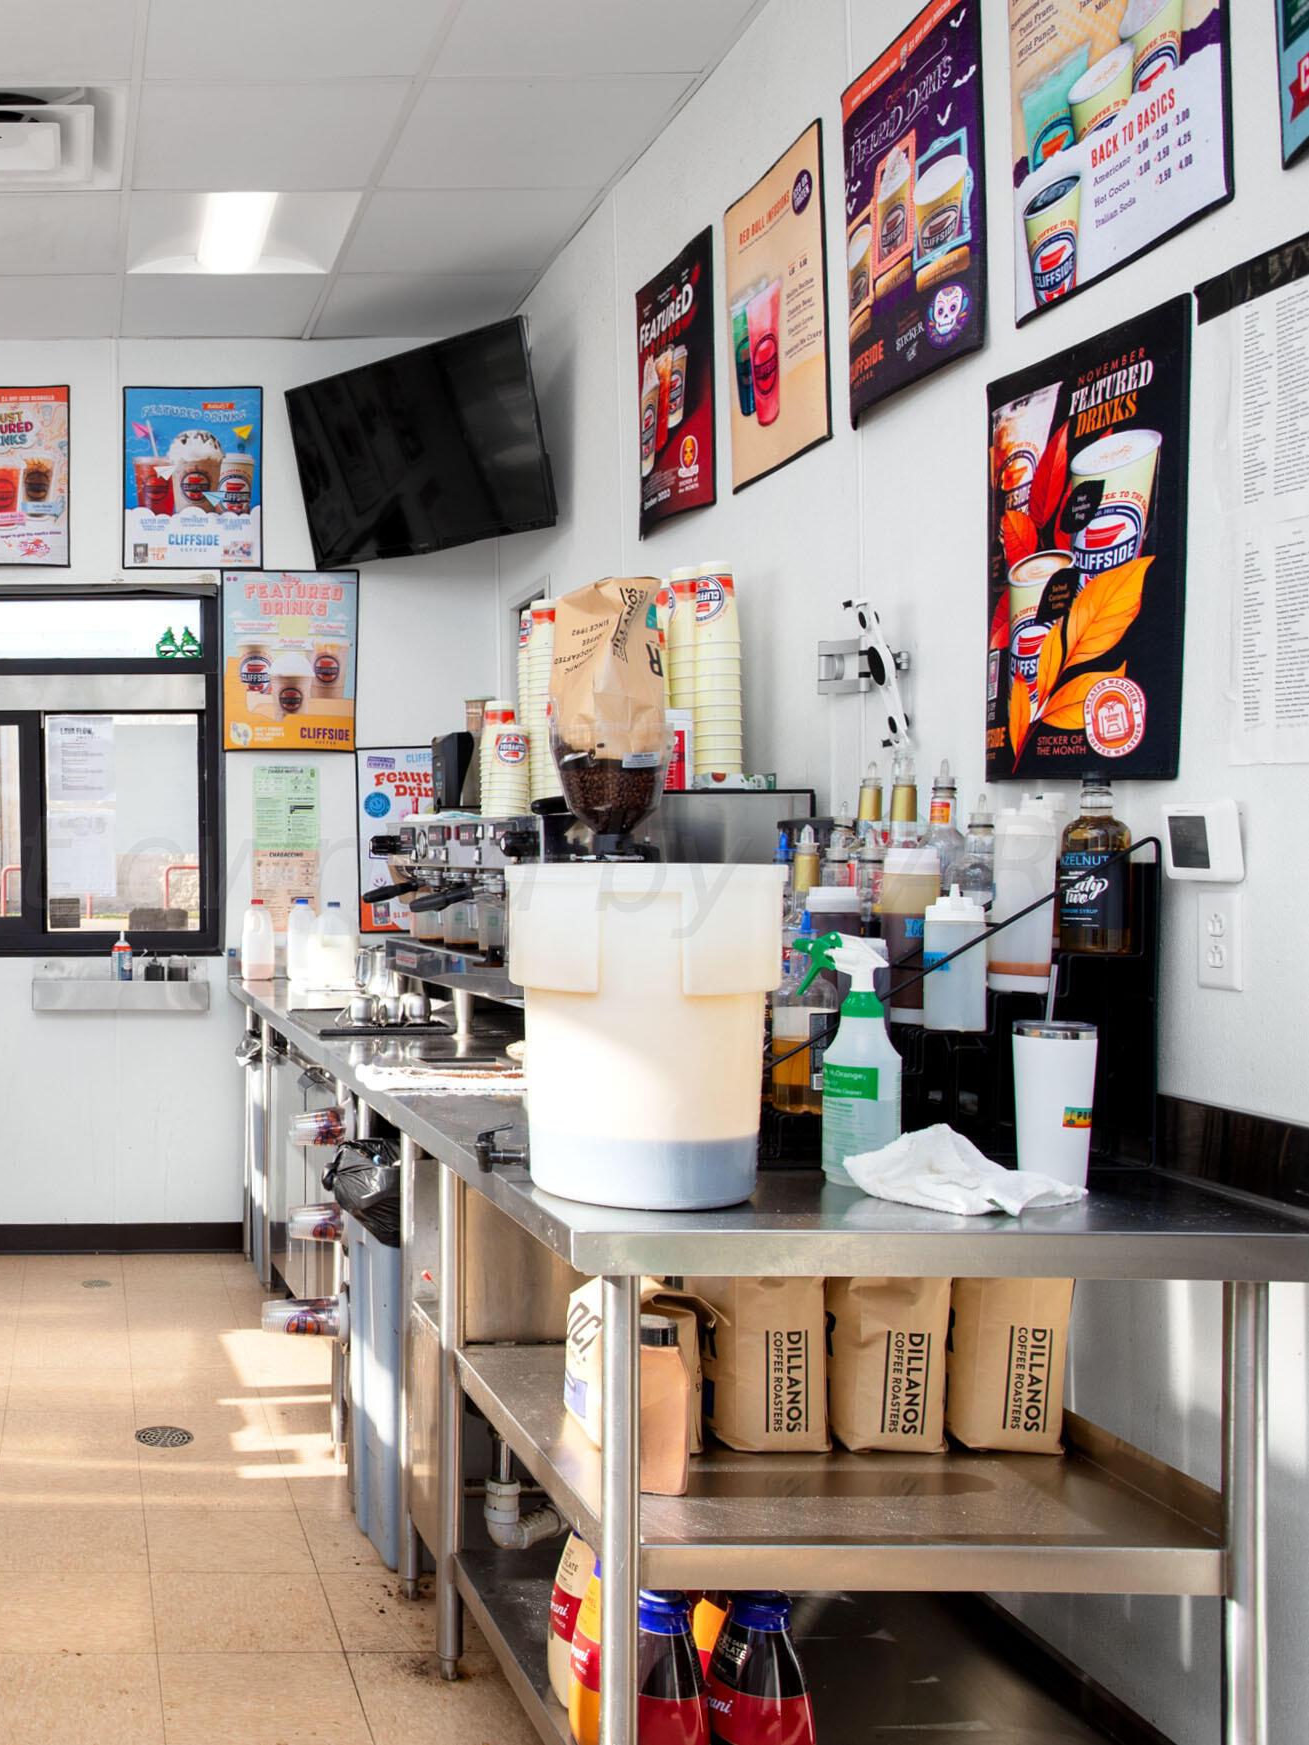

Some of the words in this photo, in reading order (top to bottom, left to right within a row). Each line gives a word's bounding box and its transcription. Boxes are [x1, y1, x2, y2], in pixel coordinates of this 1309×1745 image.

[1033, 24, 1056, 46] Punch
[850, 105, 903, 177] FEATURED
[905, 55, 953, 121] DRINKS
[1091, 132, 1119, 168] BACK
[1122, 121, 1134, 145] TO
[1137, 88, 1176, 134] BASICS
[1093, 156, 1131, 187] Americano
[1094, 194, 1107, 207] Hot
[1108, 179, 1130, 198] Cocoa
[739, 227, 750, 246] RED
[751, 215, 765, 238] BULL
[766, 189, 790, 224] INFUSIONS
[1095, 209, 1118, 228] Italian
[1119, 197, 1136, 213] Soda
[882, 227, 905, 246] CLIFFSIDE
[923, 220, 957, 247] CLIFFSIDE
[1034, 256, 1073, 288] CLIFFSIDE
[640, 283, 693, 348] FEATURED
[895, 321, 924, 351] STICKER
[1077, 347, 1145, 387] NOVEMBER
[1068, 359, 1154, 417] FEATURED
[141, 404, 202, 419] FEATURED
[203, 409, 246, 423] DRINKS
[1074, 391, 1138, 439] DRINKS
[168, 533, 220, 546] CLIFFSIDE
[1074, 539, 1135, 570] CLIFFSIDE
[244, 583, 344, 601] FEATURED
[260, 600, 328, 616] DRINKS
[571, 626, 588, 636] 1992
[590, 619, 610, 632] SINCE
[241, 673, 270, 682] CLIFFSIDE
[1086, 682, 1106, 715] SWEATER
[1108, 680, 1138, 704] WEATHER
[300, 727, 350, 741] CLIFFSIDE
[1038, 735, 1067, 746] STICKER
[1070, 735, 1084, 744] OF
[1089, 733, 1111, 755] COFFEE
[1114, 723, 1141, 754] WEATHER
[1036, 746, 1051, 756] THE
[1053, 745, 1086, 756] MONTH
[774, 1331, 783, 1373] COFFEE
[895, 1332, 907, 1374] COFFEE
[1017, 1326, 1028, 1370] COFFEE
[786, 1331, 802, 1433] DILLANOS
[901, 1332, 924, 1435] DILLANOS
[1024, 1327, 1048, 1433] DILLANOS
[773, 1377, 783, 1432] ROASTERS
[888, 1375, 902, 1433] ROASTERS
[1010, 1372, 1024, 1430] ROASTERS
